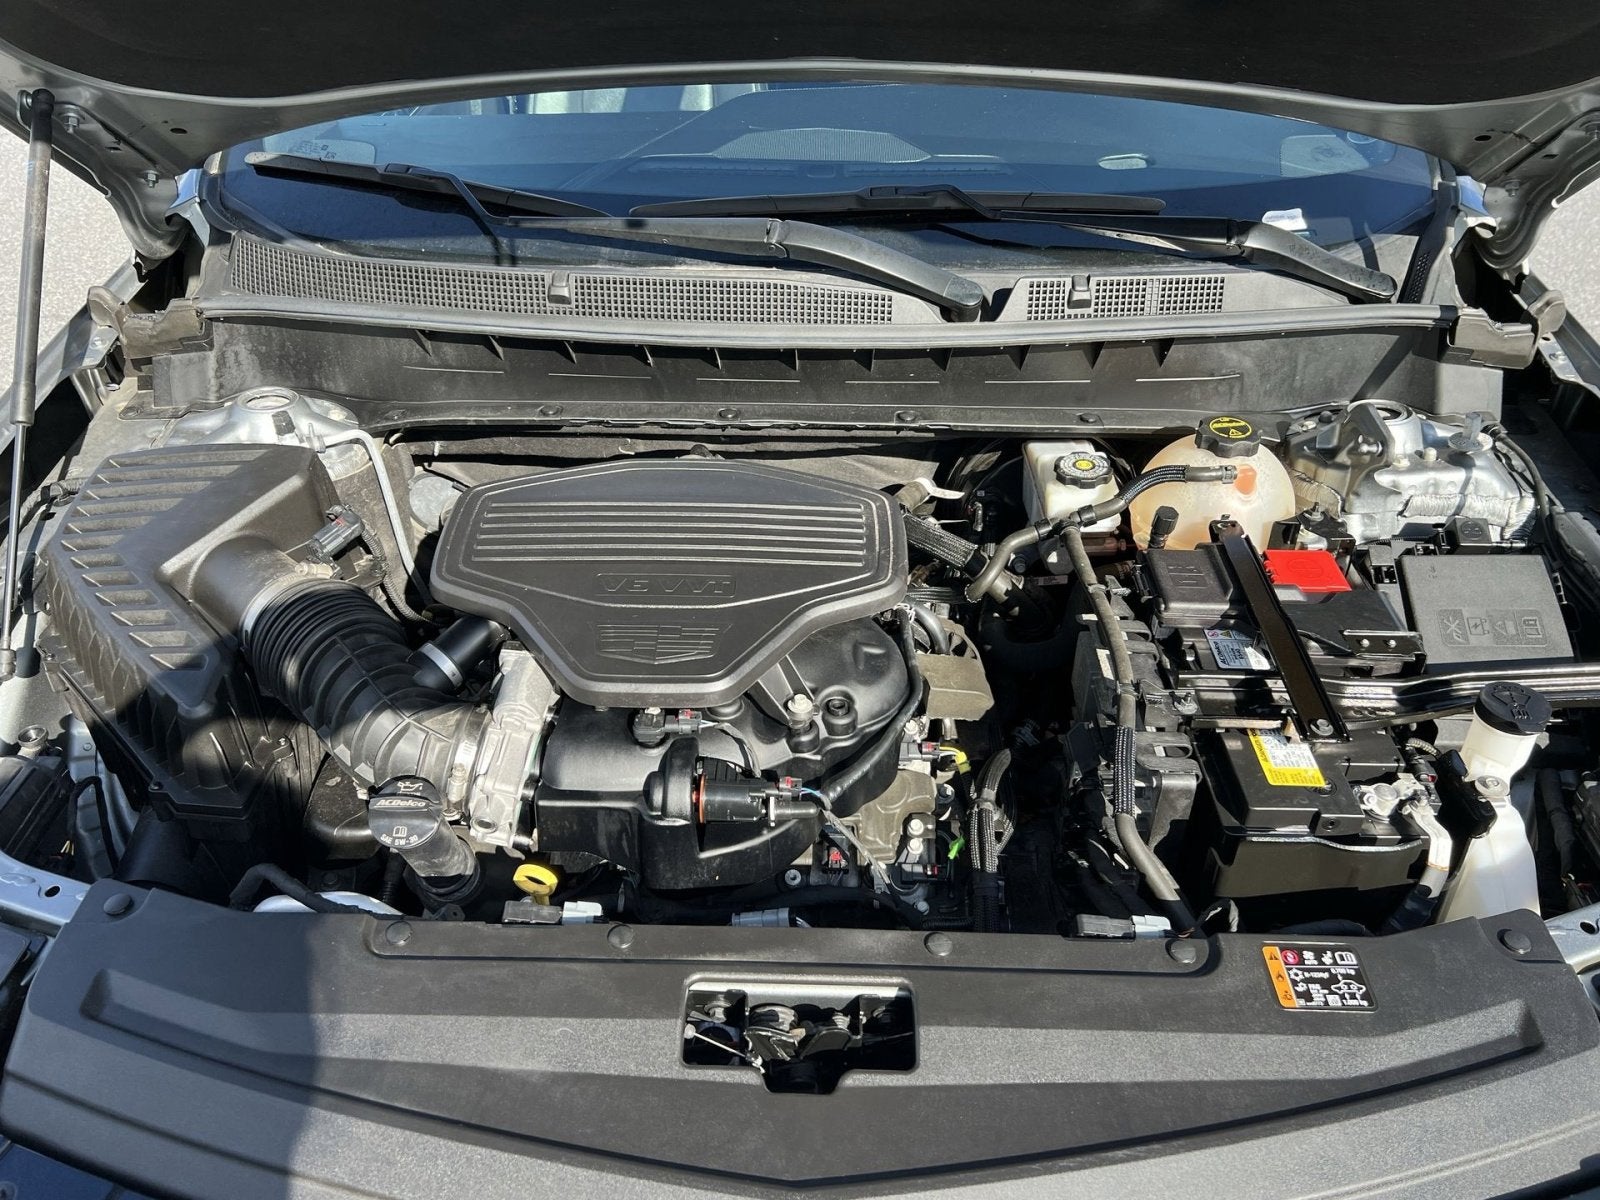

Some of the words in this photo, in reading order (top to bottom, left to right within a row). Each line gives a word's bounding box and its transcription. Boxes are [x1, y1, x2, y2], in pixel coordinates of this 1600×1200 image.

[600, 578, 649, 592] V6
[657, 578, 731, 593] VVT
[376, 799, 426, 807] ACDelco
[380, 834, 393, 844] SAE
[394, 835, 418, 845] 5W-30
